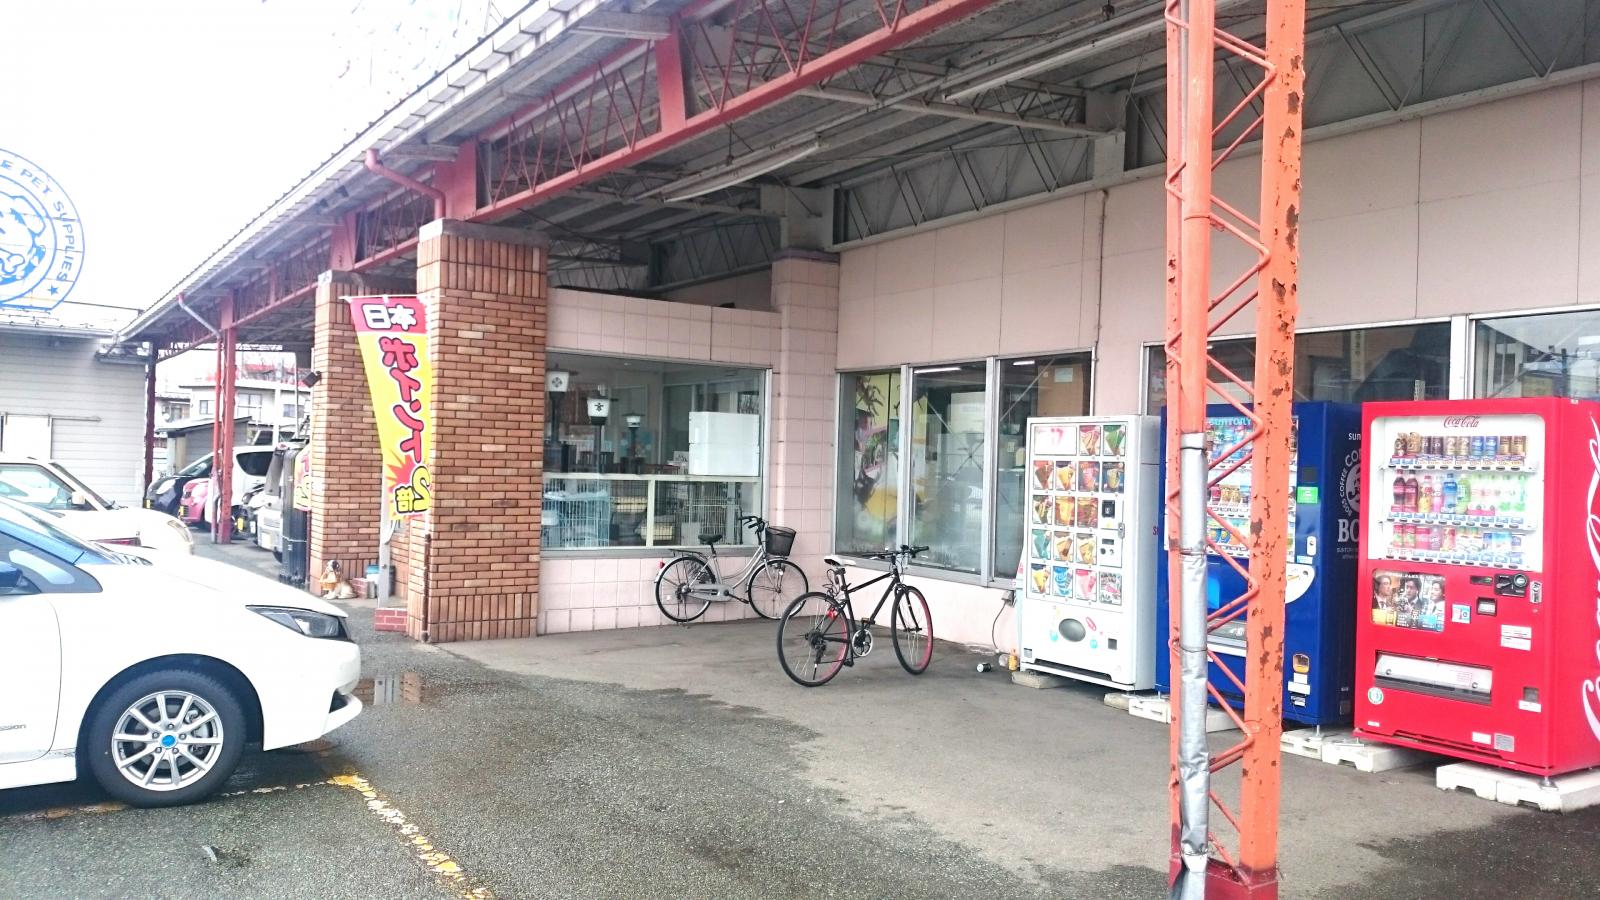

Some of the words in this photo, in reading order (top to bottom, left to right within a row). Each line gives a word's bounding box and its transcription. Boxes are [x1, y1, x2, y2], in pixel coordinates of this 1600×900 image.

[20, 168, 53, 195] PET
[52, 200, 75, 282] SUPPLIES
[1443, 415, 1481, 429] Coca-Cola
